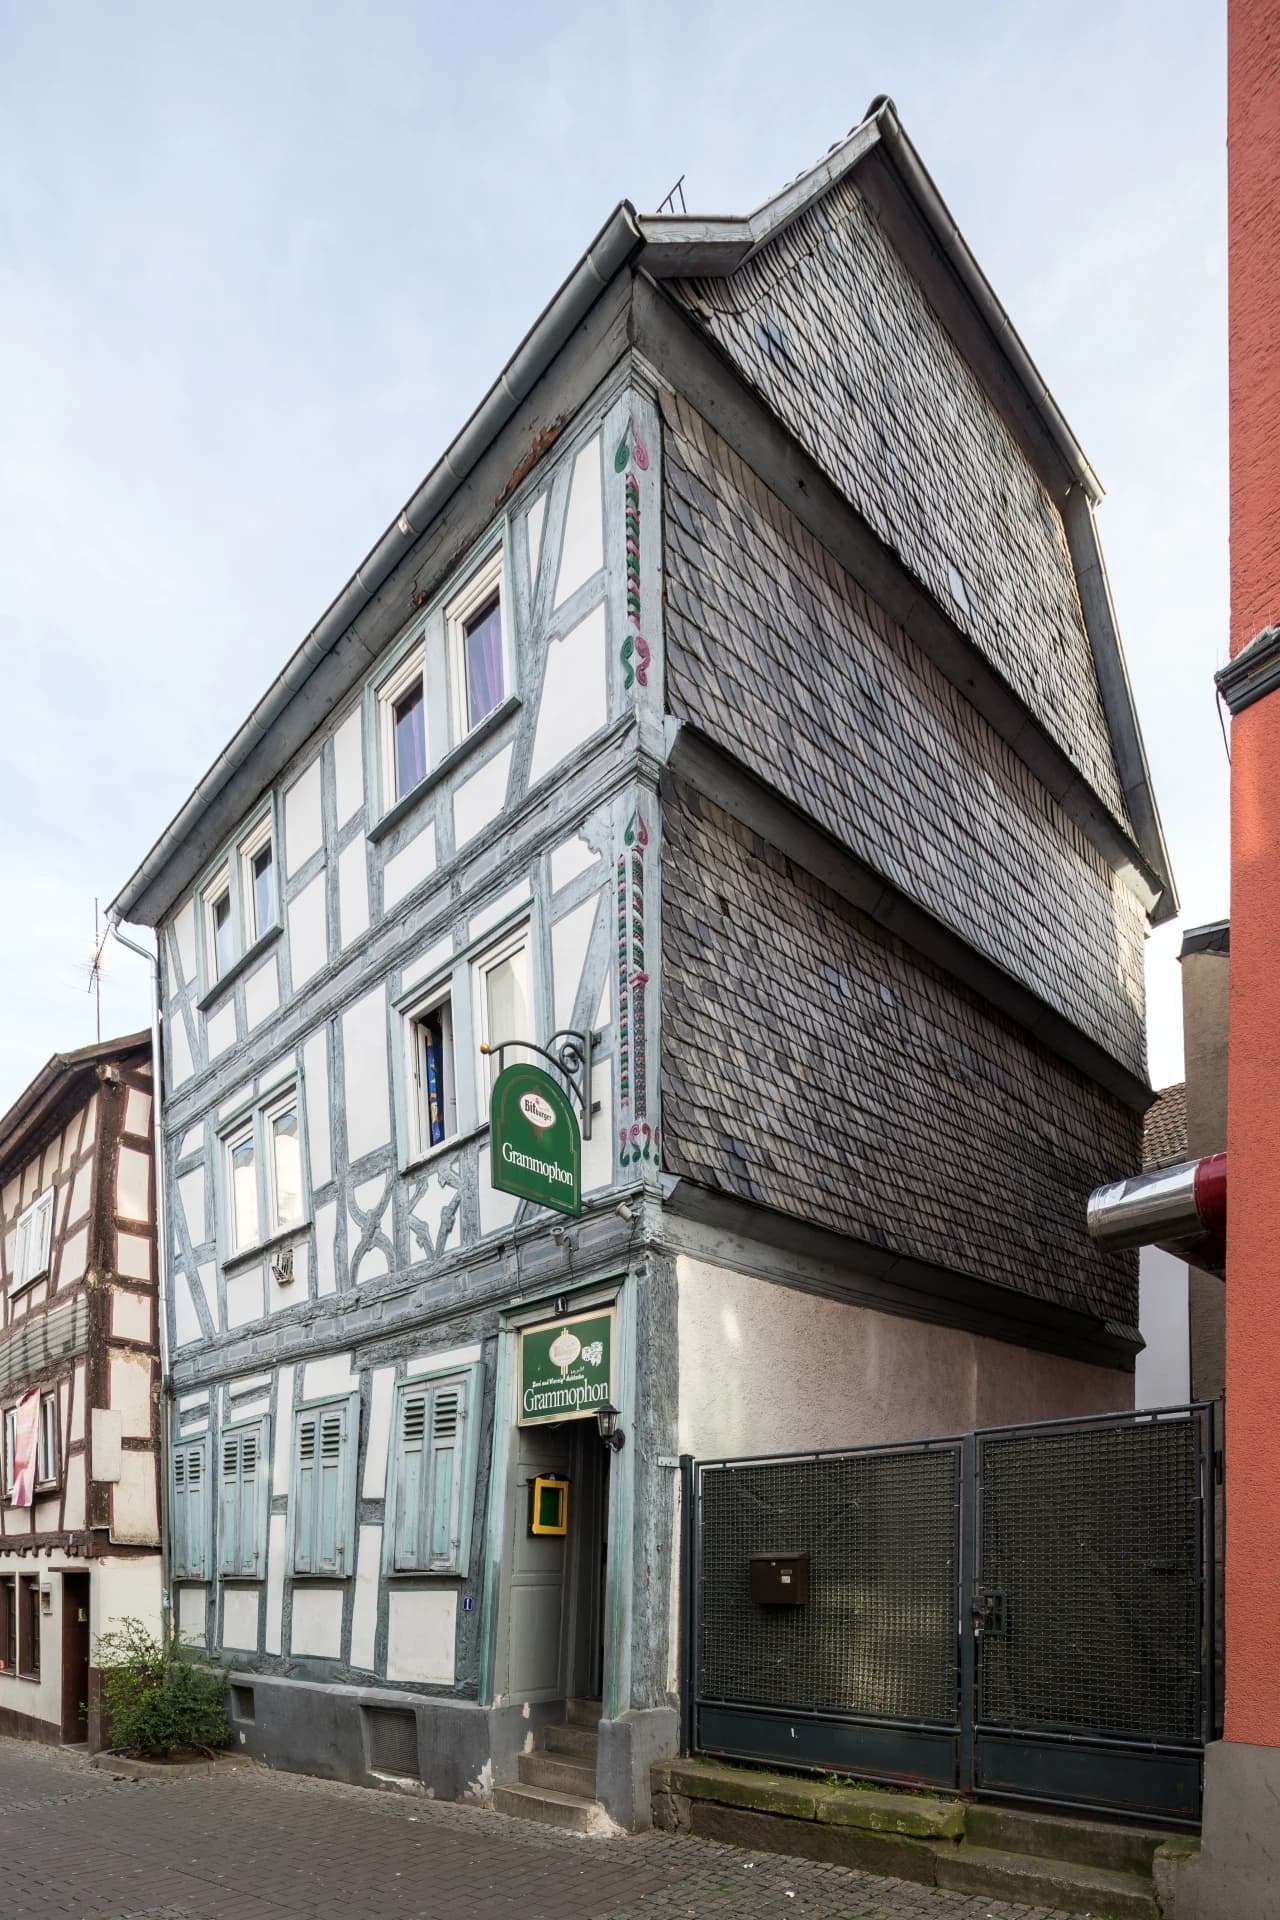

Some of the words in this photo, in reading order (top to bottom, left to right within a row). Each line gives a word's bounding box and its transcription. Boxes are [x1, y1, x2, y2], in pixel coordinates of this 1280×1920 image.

[524, 1099, 552, 1121] Bitburger
[502, 1142, 574, 1186] Grammophon
[557, 1296, 564, 1312] 1
[523, 1378, 609, 1412] Grammophon
